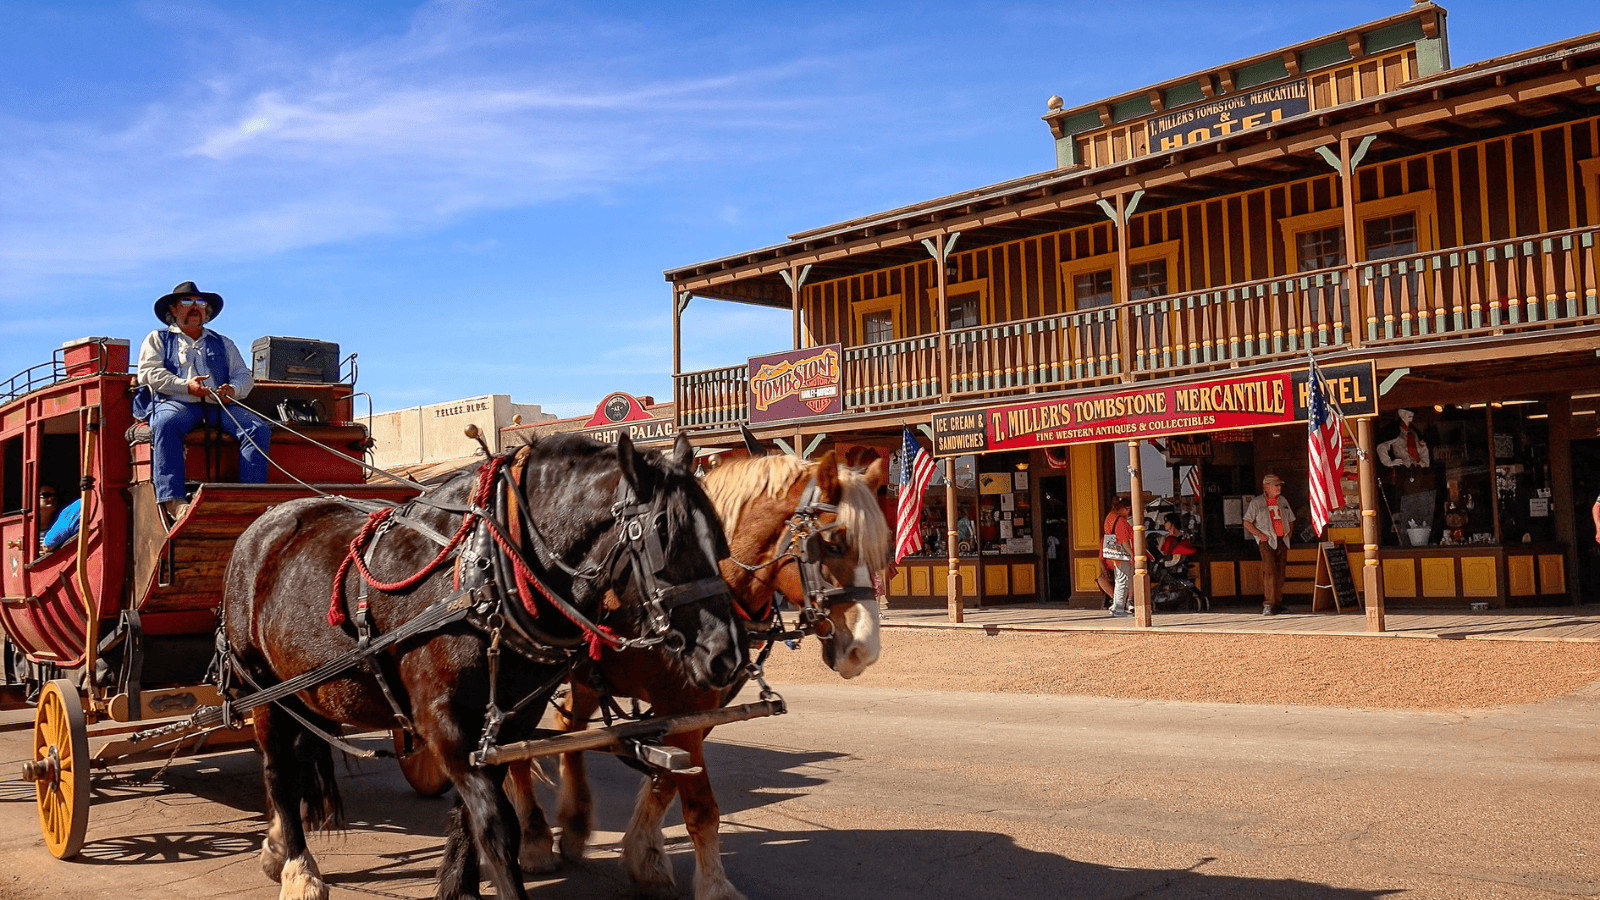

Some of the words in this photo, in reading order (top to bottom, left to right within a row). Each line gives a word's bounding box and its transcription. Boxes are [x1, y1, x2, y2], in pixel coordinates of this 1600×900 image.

[1158, 109, 1194, 134] MILLER'S
[1195, 96, 1246, 119] TOMBSTONE
[1250, 81, 1307, 106] MERCANTILE
[1219, 112, 1231, 122] &
[754, 353, 837, 407] TOMBSTONE
[992, 412, 1006, 442] T.
[1007, 403, 1072, 438] MILLER'S
[1073, 391, 1167, 423] TOMBSTONE
[1175, 379, 1286, 414] MERCANTILE
[936, 417, 948, 433] ICE
[950, 415, 975, 432] CREAM
[977, 413, 984, 428] &
[1036, 431, 1055, 442] FINE
[1056, 427, 1094, 440] WESTERN
[1095, 423, 1137, 437] ANTIQUES
[1138, 422, 1147, 432] &
[1148, 414, 1216, 431] COLLECTIBLES
[938, 432, 985, 451] SANDWICHES
[1171, 439, 1212, 456] SANDWICH
